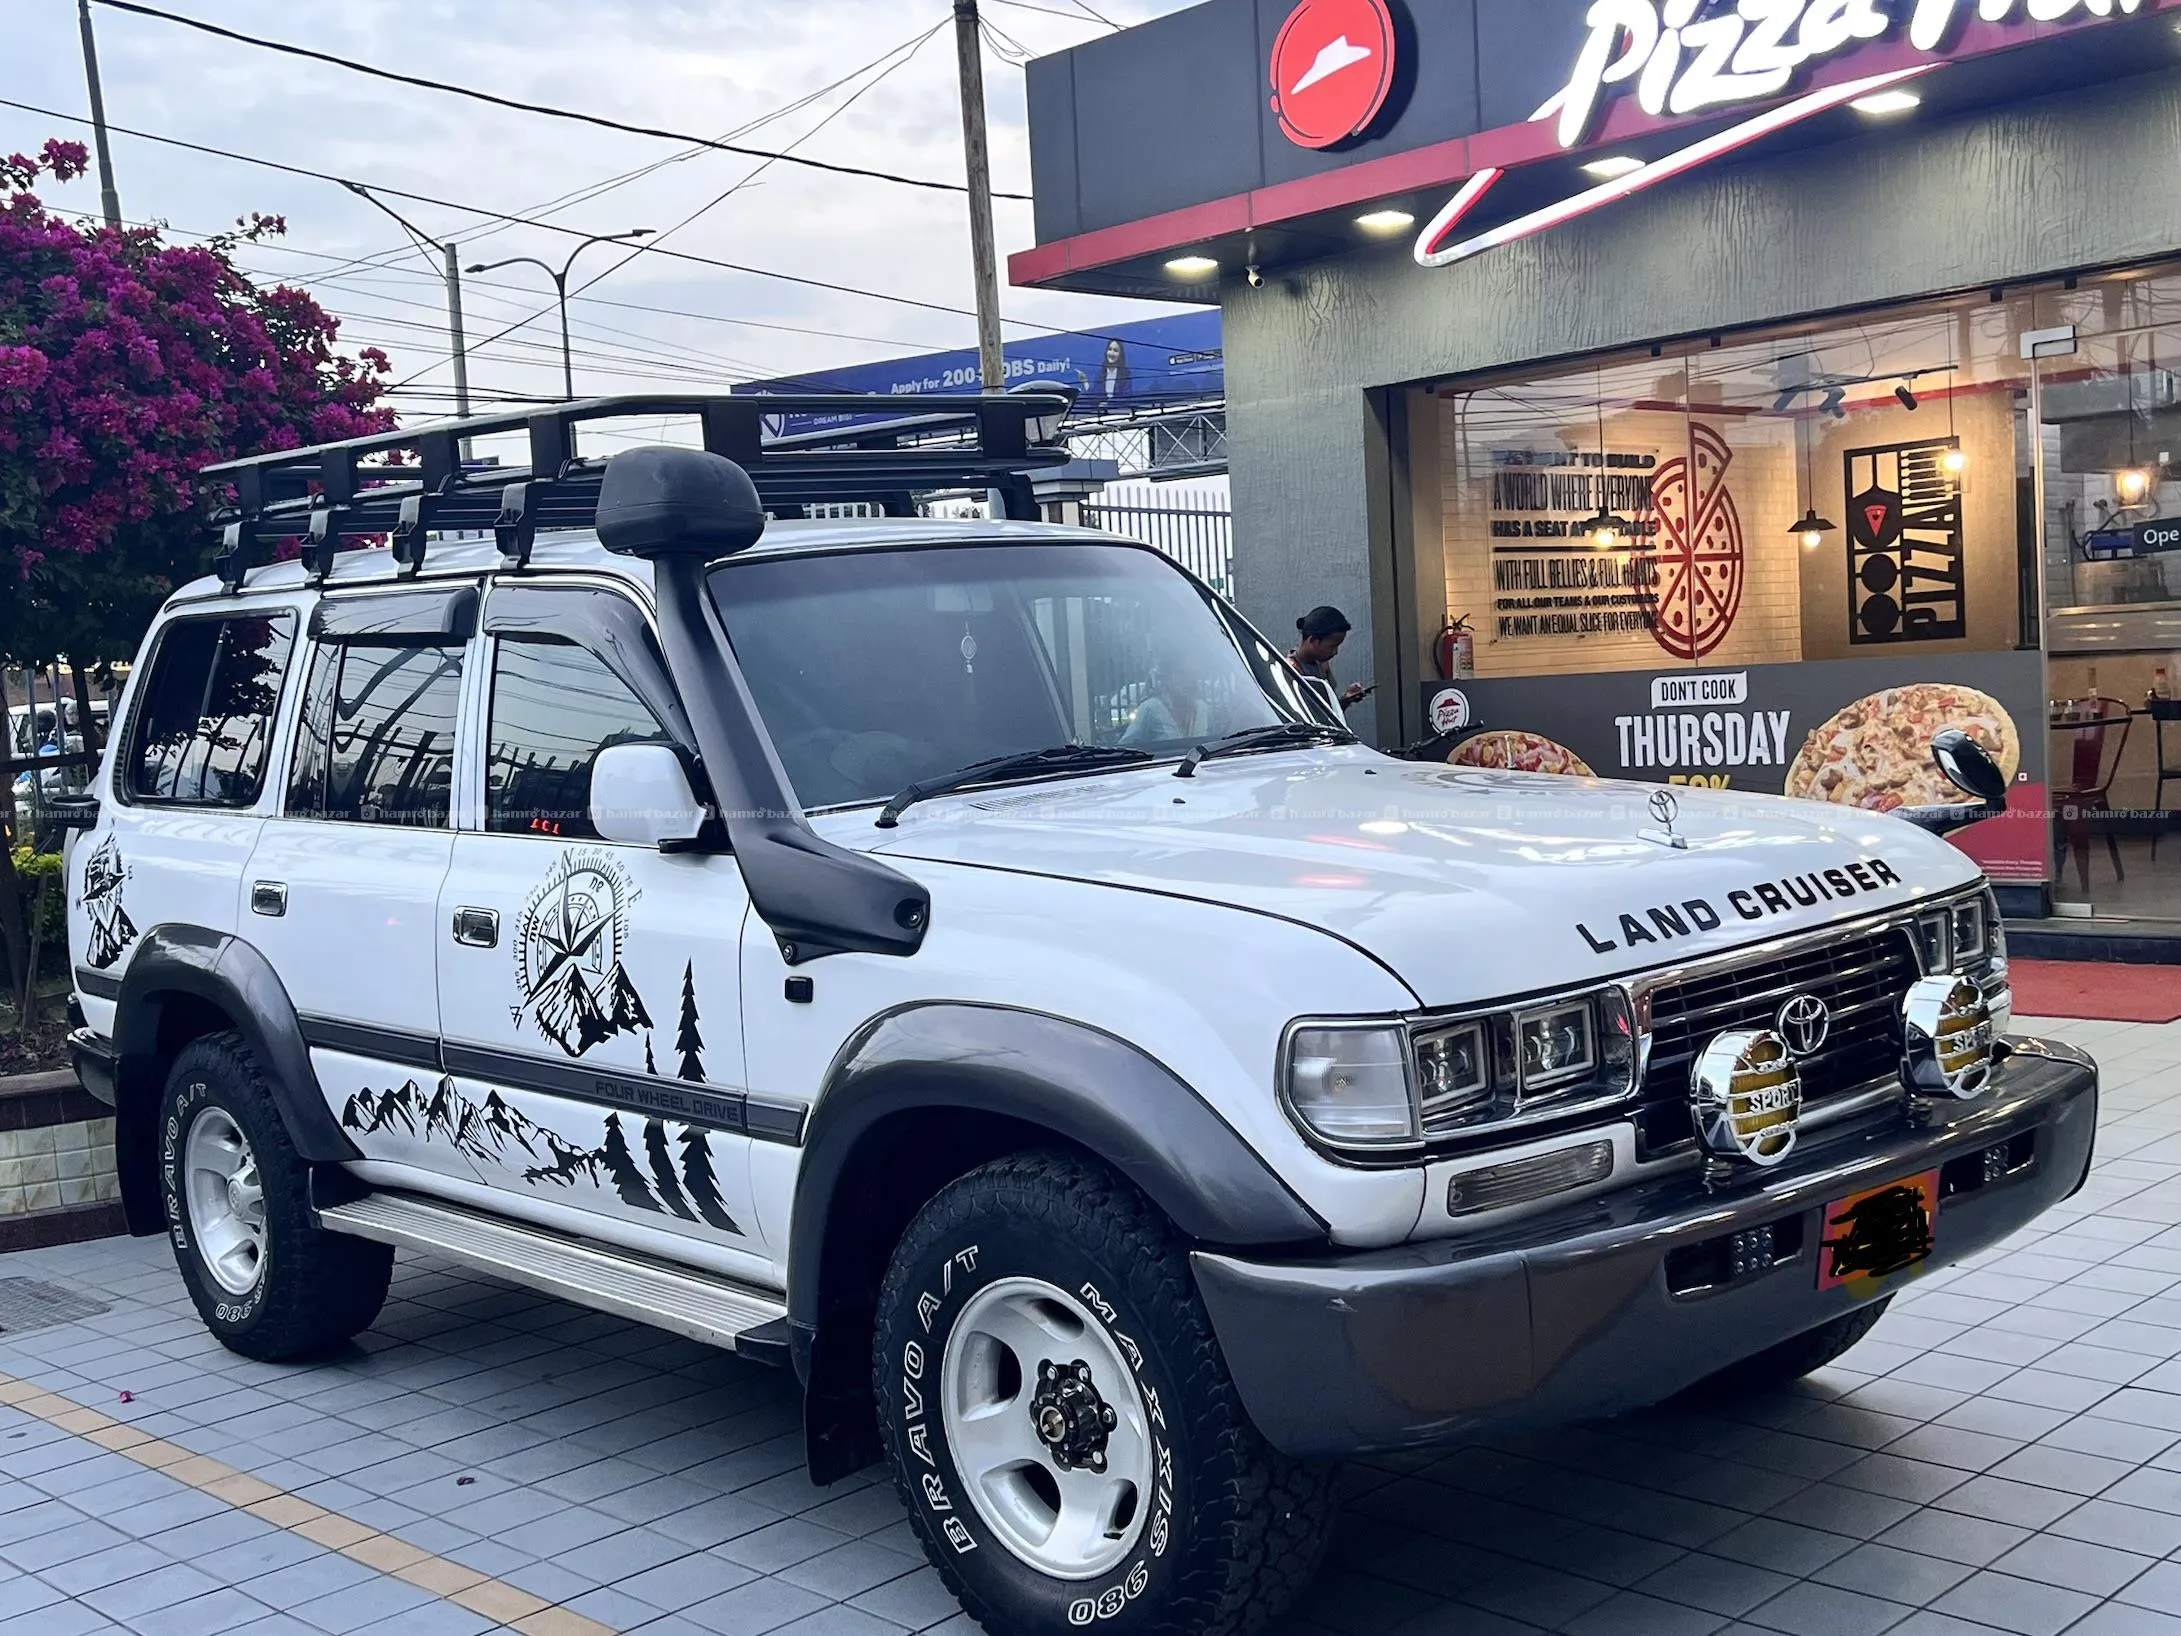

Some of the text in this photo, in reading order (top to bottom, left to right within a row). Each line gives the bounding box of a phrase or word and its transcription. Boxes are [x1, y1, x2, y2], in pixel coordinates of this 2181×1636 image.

[1527, 0, 1889, 147] Pizza
[891, 381, 922, 394] Apply
[923, 377, 940, 389] for
[1003, 359, 1034, 378] OBS
[1037, 357, 1070, 373] Daily!
[813, 415, 837, 425] DREAM
[1606, 453, 1656, 469] BUILD
[1494, 472, 1655, 511] A WORLD WHERE EVERYONE
[1490, 520, 1521, 537] HAS
[1522, 521, 1533, 537] A
[1533, 521, 1569, 537] SEAT
[2143, 529, 2180, 547] Ope
[1495, 560, 1522, 592] WITH
[1524, 559, 1548, 589] FULL
[1550, 558, 1588, 589] BELLIES
[1590, 558, 1599, 588] &
[1600, 557, 1621, 588] FULL
[1902, 502, 1963, 636] PIZZA
[1497, 598, 1514, 610] FOR
[1516, 597, 1533, 609] ALL
[1533, 596, 1553, 608] OUR
[1553, 595, 1583, 607] TEAMS
[1584, 595, 1592, 606] &
[1592, 595, 1610, 606] OUR
[1498, 616, 1513, 637] WE
[1513, 615, 1539, 636] WANT
[1539, 614, 1551, 635] AN
[1552, 613, 1579, 635] EQUAL
[1580, 612, 1603, 633] SLICE
[1603, 612, 1619, 632] FOR
[1661, 679, 1736, 701] DON'T COOK
[1437, 708, 1459, 721] Pizza
[1615, 711, 1791, 768] THURSDAY
[589, 876, 604, 893] ne
[1576, 859, 1902, 954] LAND CRUISER
[595, 1081, 738, 1122] FOUR WHEEL DRIVE
[1750, 1082, 1799, 1114] SPORT
[164, 1083, 207, 1249] BRAVO A/T
[903, 1245, 980, 1554] BRAVO A/T
[1079, 1281, 1174, 1557] MAXXIS
[1067, 1559, 1149, 1626] 980
